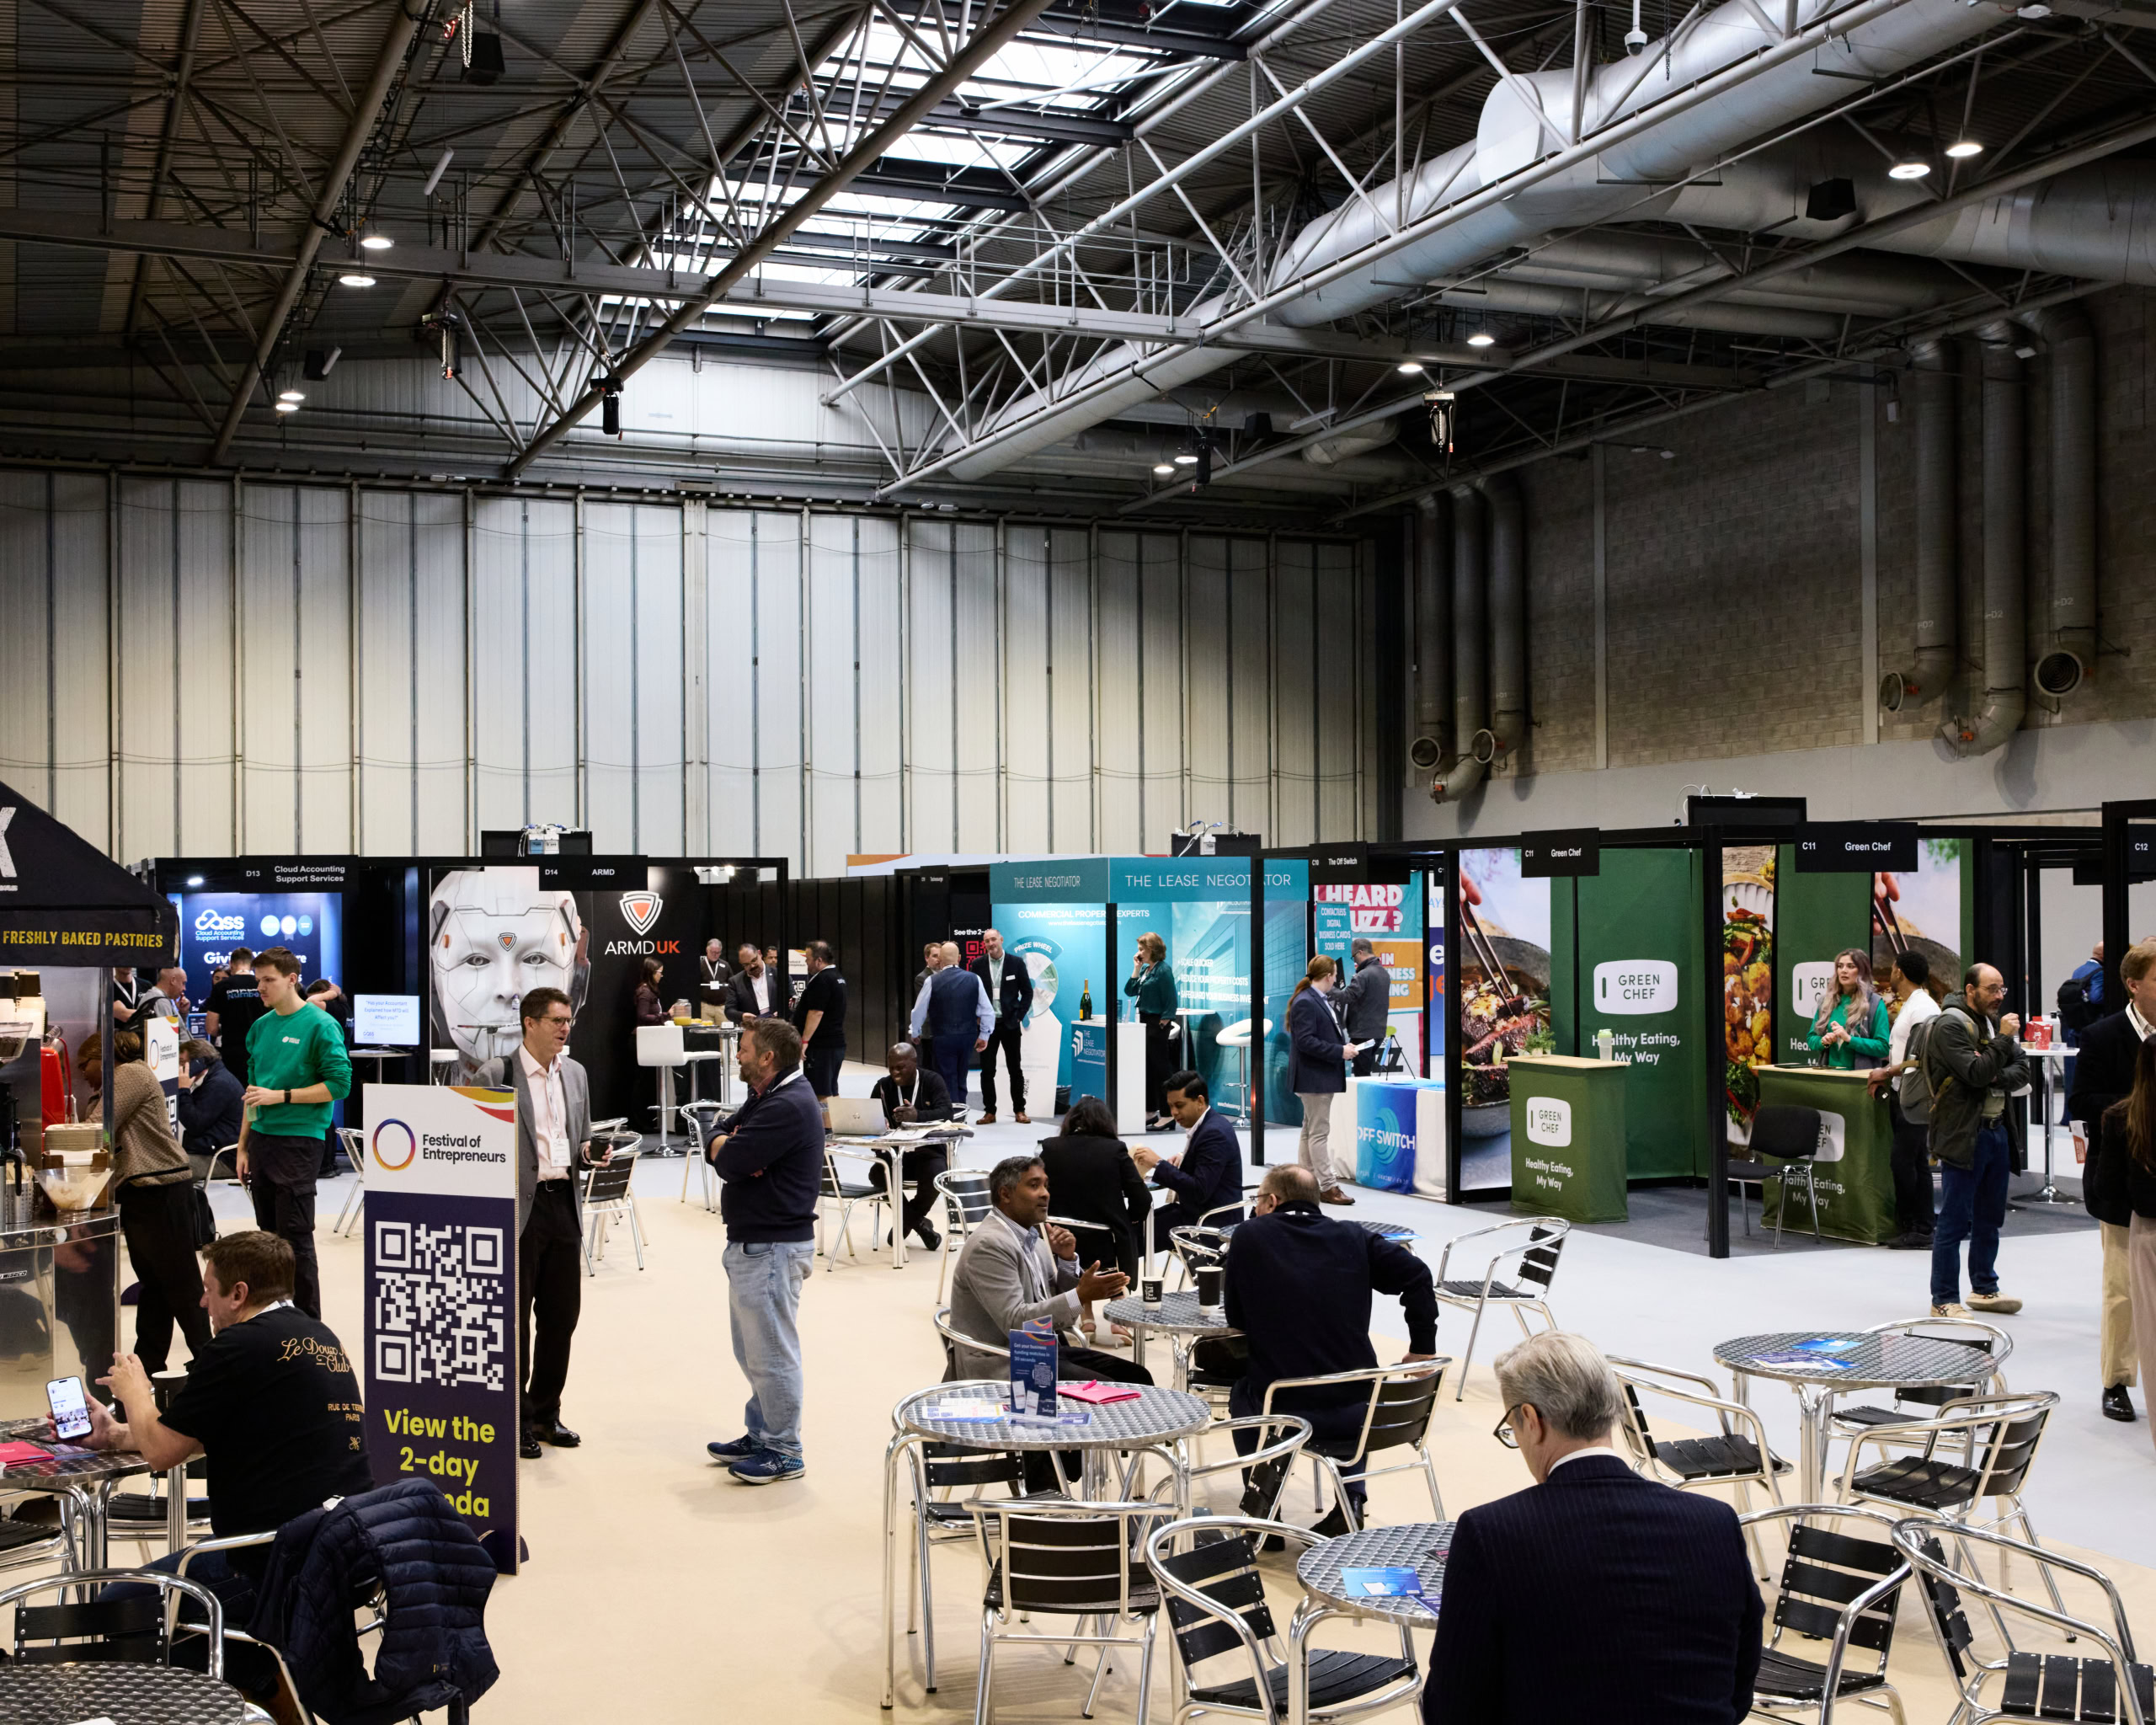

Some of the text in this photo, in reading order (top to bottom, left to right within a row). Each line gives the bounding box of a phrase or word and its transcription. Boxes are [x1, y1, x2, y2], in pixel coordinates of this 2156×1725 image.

[1550, 848, 1582, 857] Green Chef
[1844, 841, 1892, 851] Green Chef
[300, 866, 345, 874] Accounting
[1014, 876, 1081, 889] THE LEASE NEGOTIATOR
[1125, 874, 1291, 887] THE LEASE NEGOTTOR
[1325, 885, 1403, 906] HEARD
[3, 931, 163, 948] FRESHLY BAKED PASTRIES
[1335, 942, 1345, 950] HERE
[1014, 942, 1053, 953] PRIZE WHEEL
[1194, 959, 1213, 967] QUICKER
[1232, 977, 1248, 986] COSTS
[1618, 975, 1661, 985] GREEN
[1623, 989, 1656, 1000] CHEF
[1641, 1033, 1680, 1047] Eating,
[1635, 1051, 1660, 1065] Way
[1539, 1109, 1561, 1122] GREEN
[1541, 1122, 1559, 1134] CHEF
[423, 1134, 481, 1148] Festival of
[1376, 1130, 1415, 1150] SWITCH
[423, 1148, 506, 1164] Entrepreneurs
[1525, 1157, 1574, 1178] Healthy Eating,
[1536, 1176, 1562, 1192] My Way
[1813, 1178, 1845, 1194] Eating,
[1792, 1192, 1806, 1205] My
[277, 1338, 303, 1361] Le
[345, 1413, 360, 1422] PARIS
[384, 1408, 495, 1444] View the
[400, 1446, 479, 1487] 2-day
